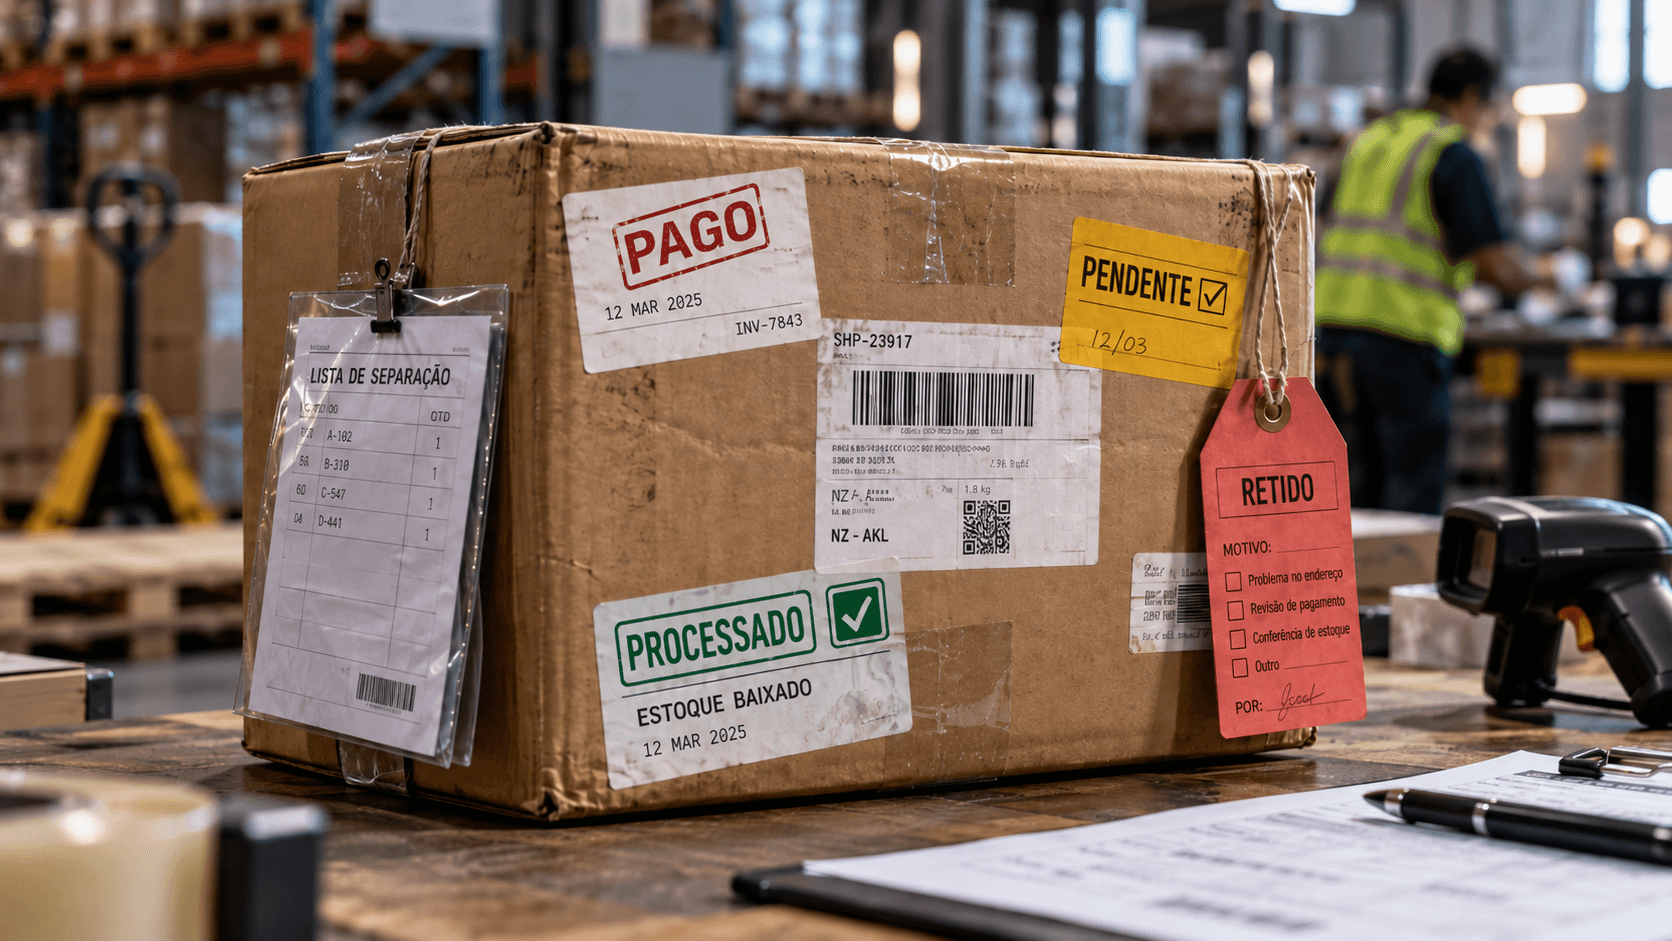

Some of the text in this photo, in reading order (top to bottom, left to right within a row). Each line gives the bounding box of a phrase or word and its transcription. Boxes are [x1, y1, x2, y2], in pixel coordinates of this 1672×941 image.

[624, 200, 757, 275] PAGO
[1081, 255, 1193, 307] PENDENTE
[605, 292, 703, 321] 12 MAR 2025
[735, 313, 803, 336] INV-7843
[833, 333, 912, 349] SHP-23917
[1092, 330, 1147, 355] 12/03
[310, 364, 451, 390] LISTA DE SEPARAÇÃO
[430, 411, 451, 423] QTD
[327, 429, 353, 443] A-102
[435, 437, 441, 450] 1
[324, 458, 349, 471] B-310
[432, 467, 437, 480] 1
[320, 487, 346, 500] C-547
[964, 485, 978, 494] 1.8
[980, 484, 991, 496] kg
[1241, 473, 1315, 507] RETIDO
[427, 497, 433, 510] 1
[318, 515, 343, 529] D-441
[424, 528, 430, 541] 1
[831, 528, 849, 543] NZ
[862, 528, 889, 543] AKL
[1223, 541, 1272, 557] MOTIVO:
[1248, 569, 1344, 587] Problema no endereço
[1250, 595, 1346, 617] Revisão de pagamento
[626, 605, 805, 671] PROCESSADO
[1305, 627, 1315, 639] de
[1317, 623, 1351, 641] estoque
[1255, 659, 1280, 673] Outro
[636, 678, 812, 727] ESTOQUE BAIXADO
[1235, 699, 1263, 715] POR:
[643, 724, 747, 758] 12 MAR 2025
